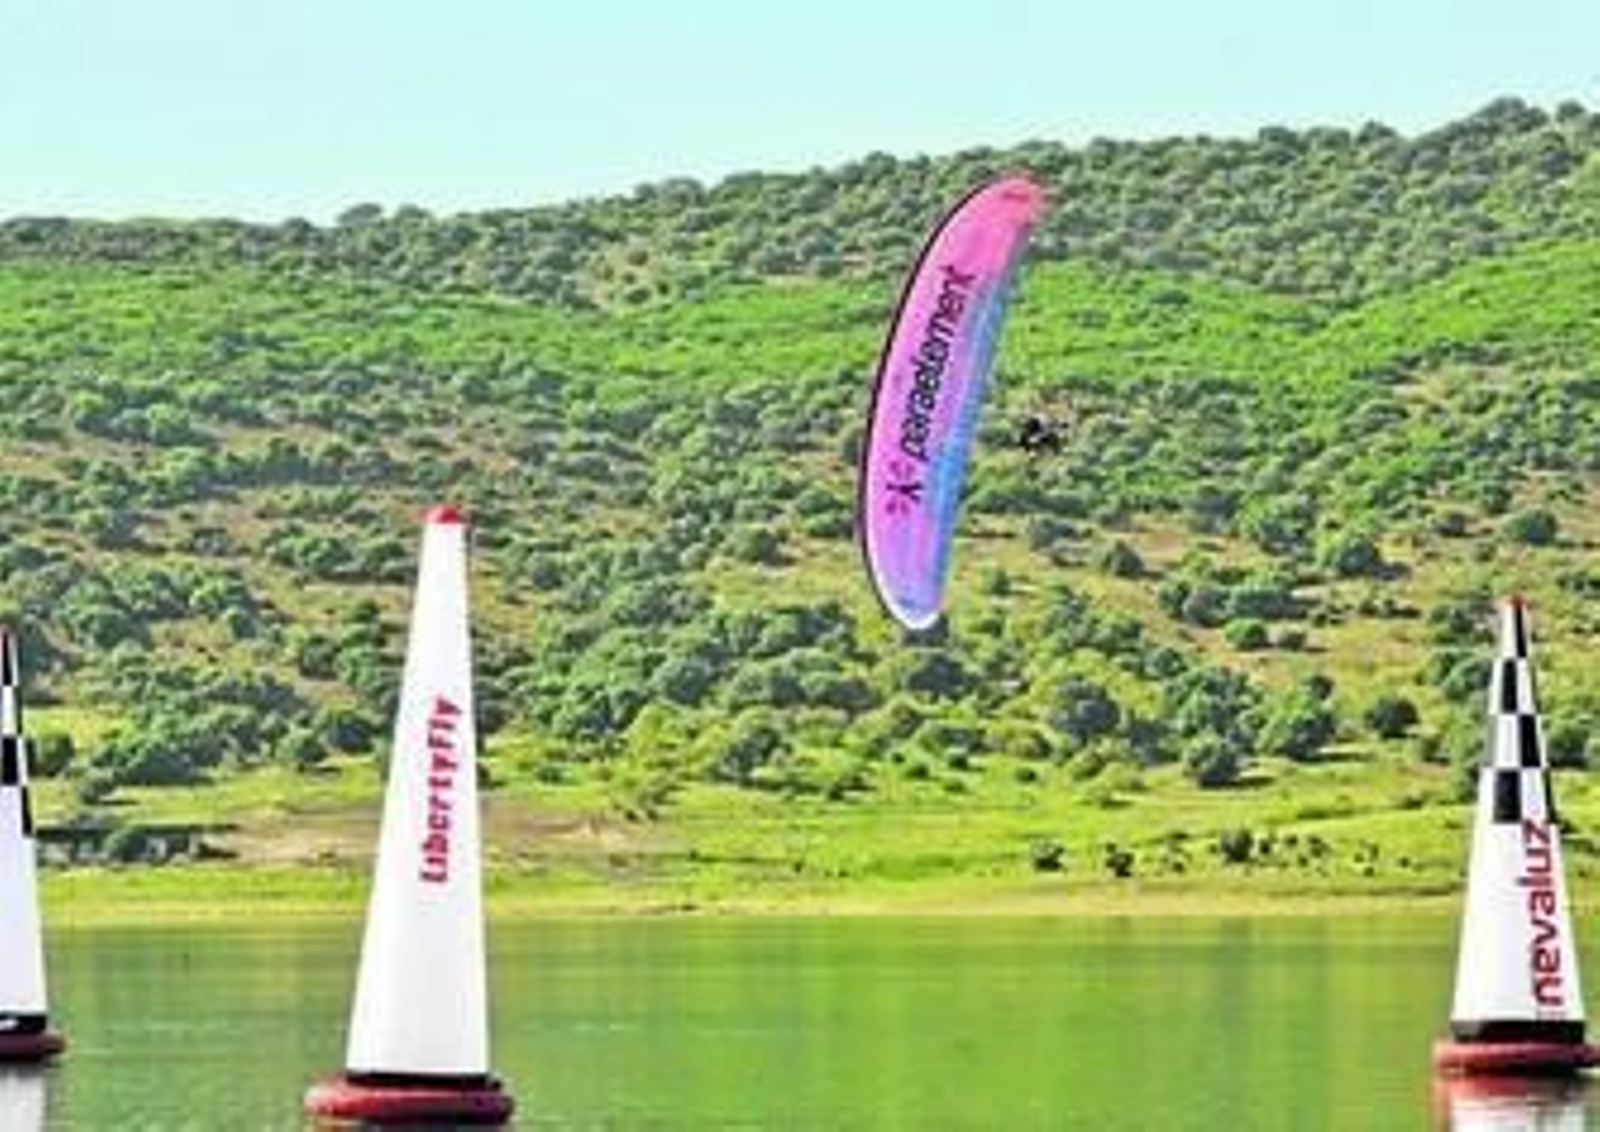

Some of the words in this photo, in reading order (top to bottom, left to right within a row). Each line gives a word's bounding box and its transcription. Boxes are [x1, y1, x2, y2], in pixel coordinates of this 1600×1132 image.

[901, 264, 976, 461] paraelement
[421, 697, 463, 882] LibertyFly
[1517, 819, 1564, 1005] nevaluz
